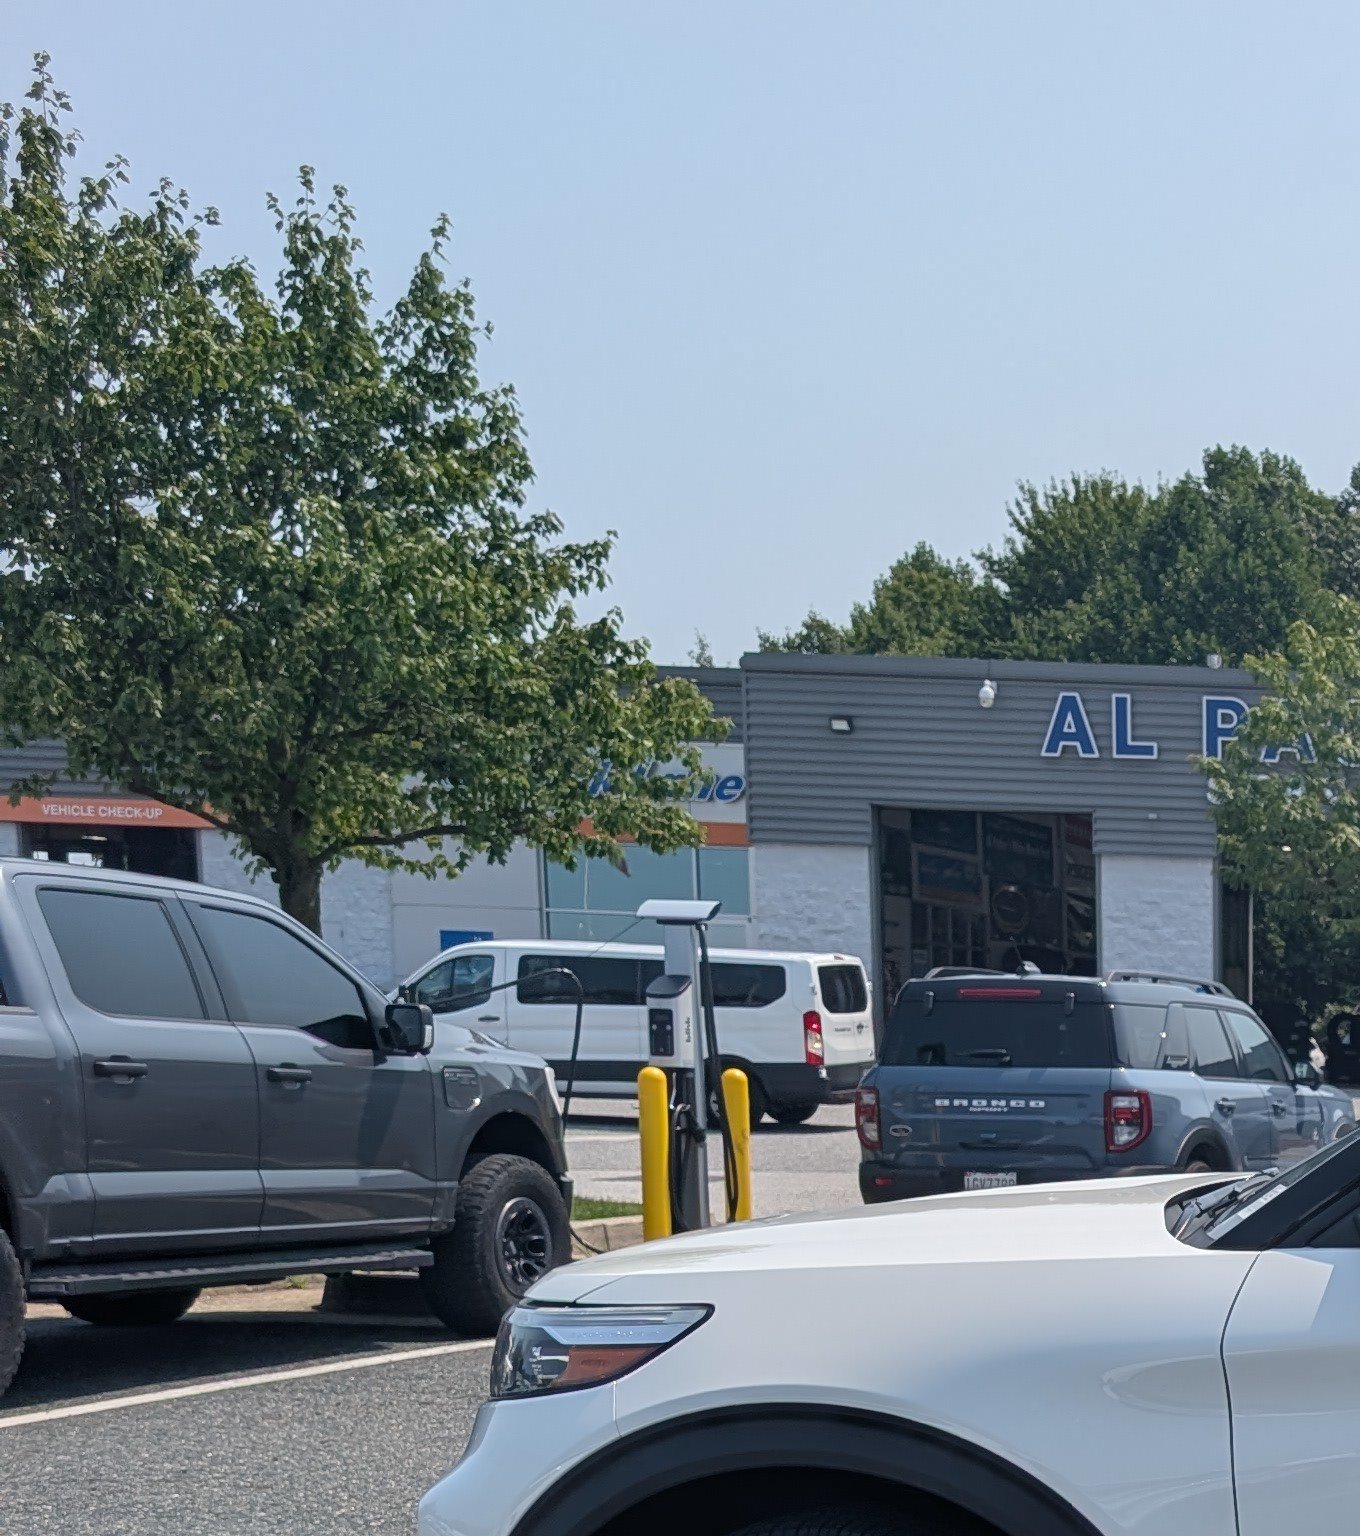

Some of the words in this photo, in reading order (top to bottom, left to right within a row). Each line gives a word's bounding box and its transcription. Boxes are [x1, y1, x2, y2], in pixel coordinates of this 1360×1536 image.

[1040, 691, 1158, 760] AL
[42, 804, 95, 817] VEHICLE
[98, 805, 163, 819] CHECK-UP
[934, 1098, 1046, 1108] BRONCO
